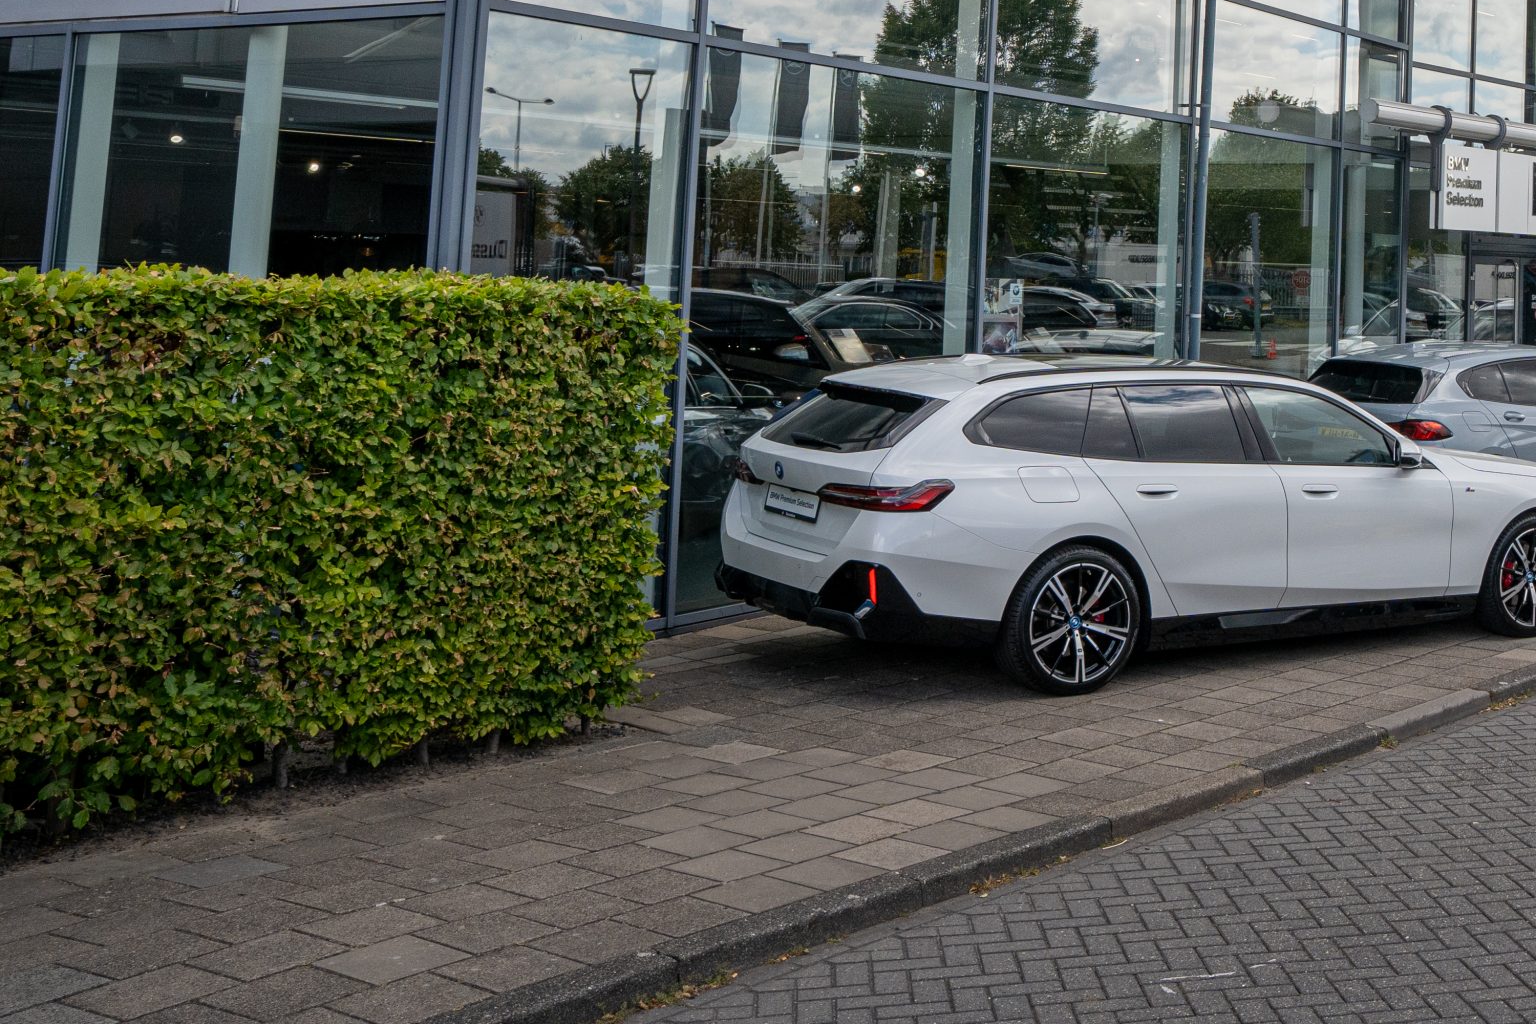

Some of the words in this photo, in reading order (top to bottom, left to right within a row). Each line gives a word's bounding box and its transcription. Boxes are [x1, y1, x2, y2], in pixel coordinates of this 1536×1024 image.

[1447, 155, 1470, 171] BMW
[1446, 173, 1482, 190] Premium
[1446, 190, 1484, 208] Selection
[770, 491, 780, 500] BMW
[780, 494, 797, 505] Premium
[797, 498, 815, 509] Selection
